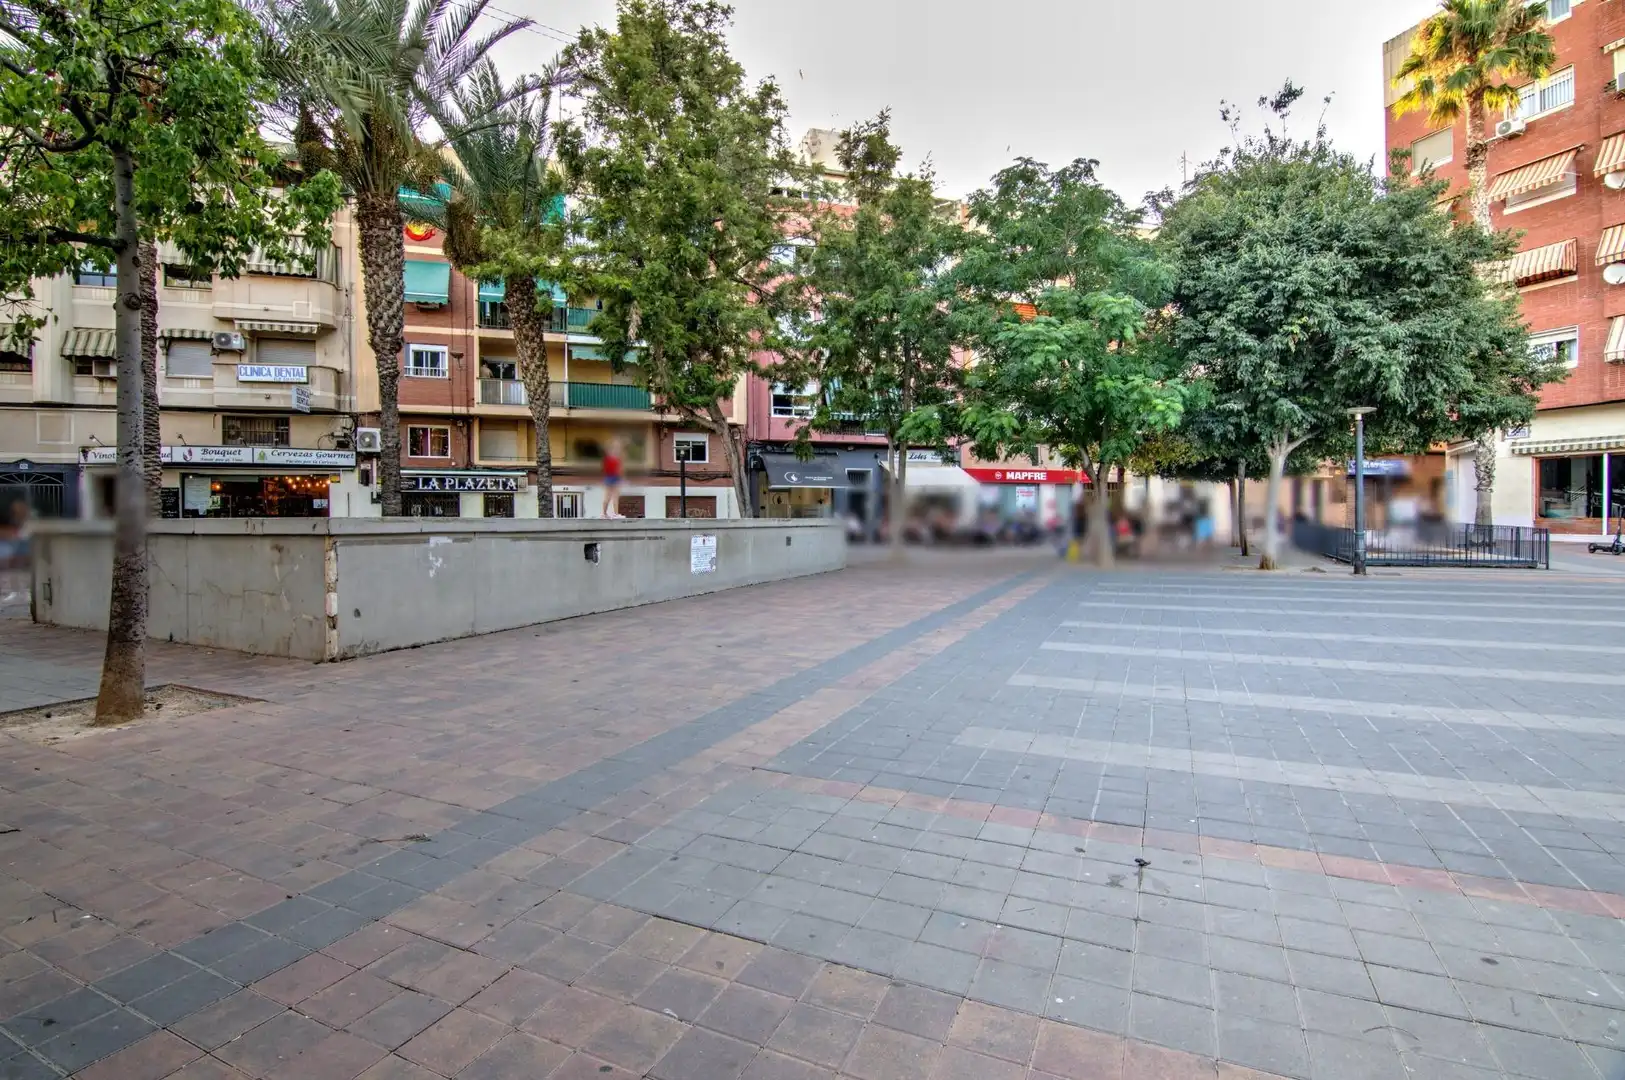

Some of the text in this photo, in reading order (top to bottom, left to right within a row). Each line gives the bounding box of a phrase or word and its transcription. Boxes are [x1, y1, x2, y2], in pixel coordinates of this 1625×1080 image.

[240, 366, 304, 378] CLINICA DENTAL
[92, 451, 116, 459] Vinot
[201, 448, 242, 457] Bouquet
[270, 449, 354, 459] Cervezas Gourmet
[1006, 471, 1047, 480] MAPFRE
[418, 477, 440, 490] LA
[444, 477, 517, 490] PLAZETA
